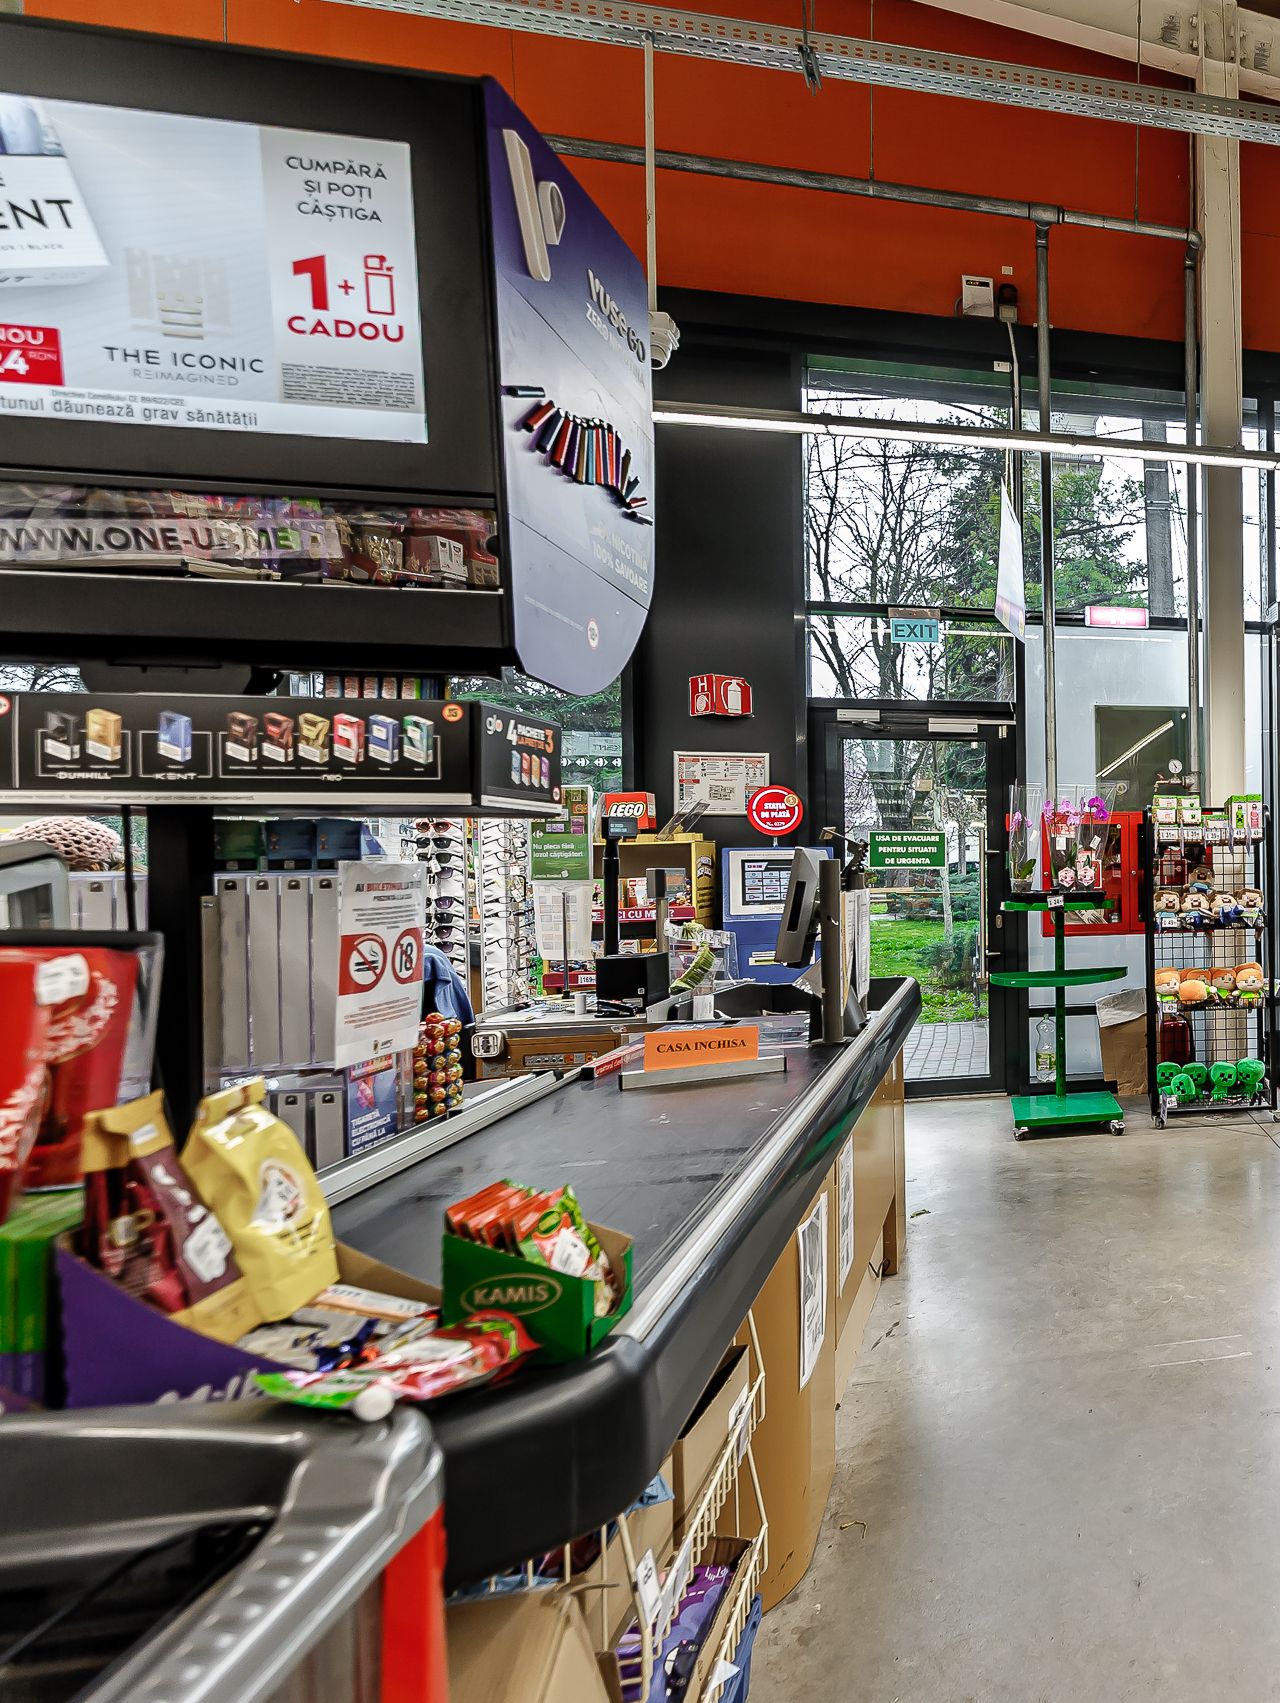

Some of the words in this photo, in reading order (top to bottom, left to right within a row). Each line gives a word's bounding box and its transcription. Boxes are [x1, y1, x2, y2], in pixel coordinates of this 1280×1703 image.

[286, 156, 388, 180] CUMPĂRĂ
[328, 182, 373, 203] POȚI
[297, 199, 383, 223] CÂȘTIGA
[287, 315, 405, 343] CADOU
[103, 346, 161, 365] THE
[173, 352, 265, 373] ICONIC
[132, 368, 240, 386] REIMAGINED
[53, 400, 134, 417] dăunează
[143, 407, 179, 422] grav
[894, 624, 936, 638] EXIT
[506, 719, 518, 746] 4
[610, 803, 645, 816] LEGO
[628, 910, 642, 919] CU
[656, 1043, 690, 1053] CASA
[694, 1039, 747, 1050] INCHISA
[473, 1284, 549, 1305] KAMIS
